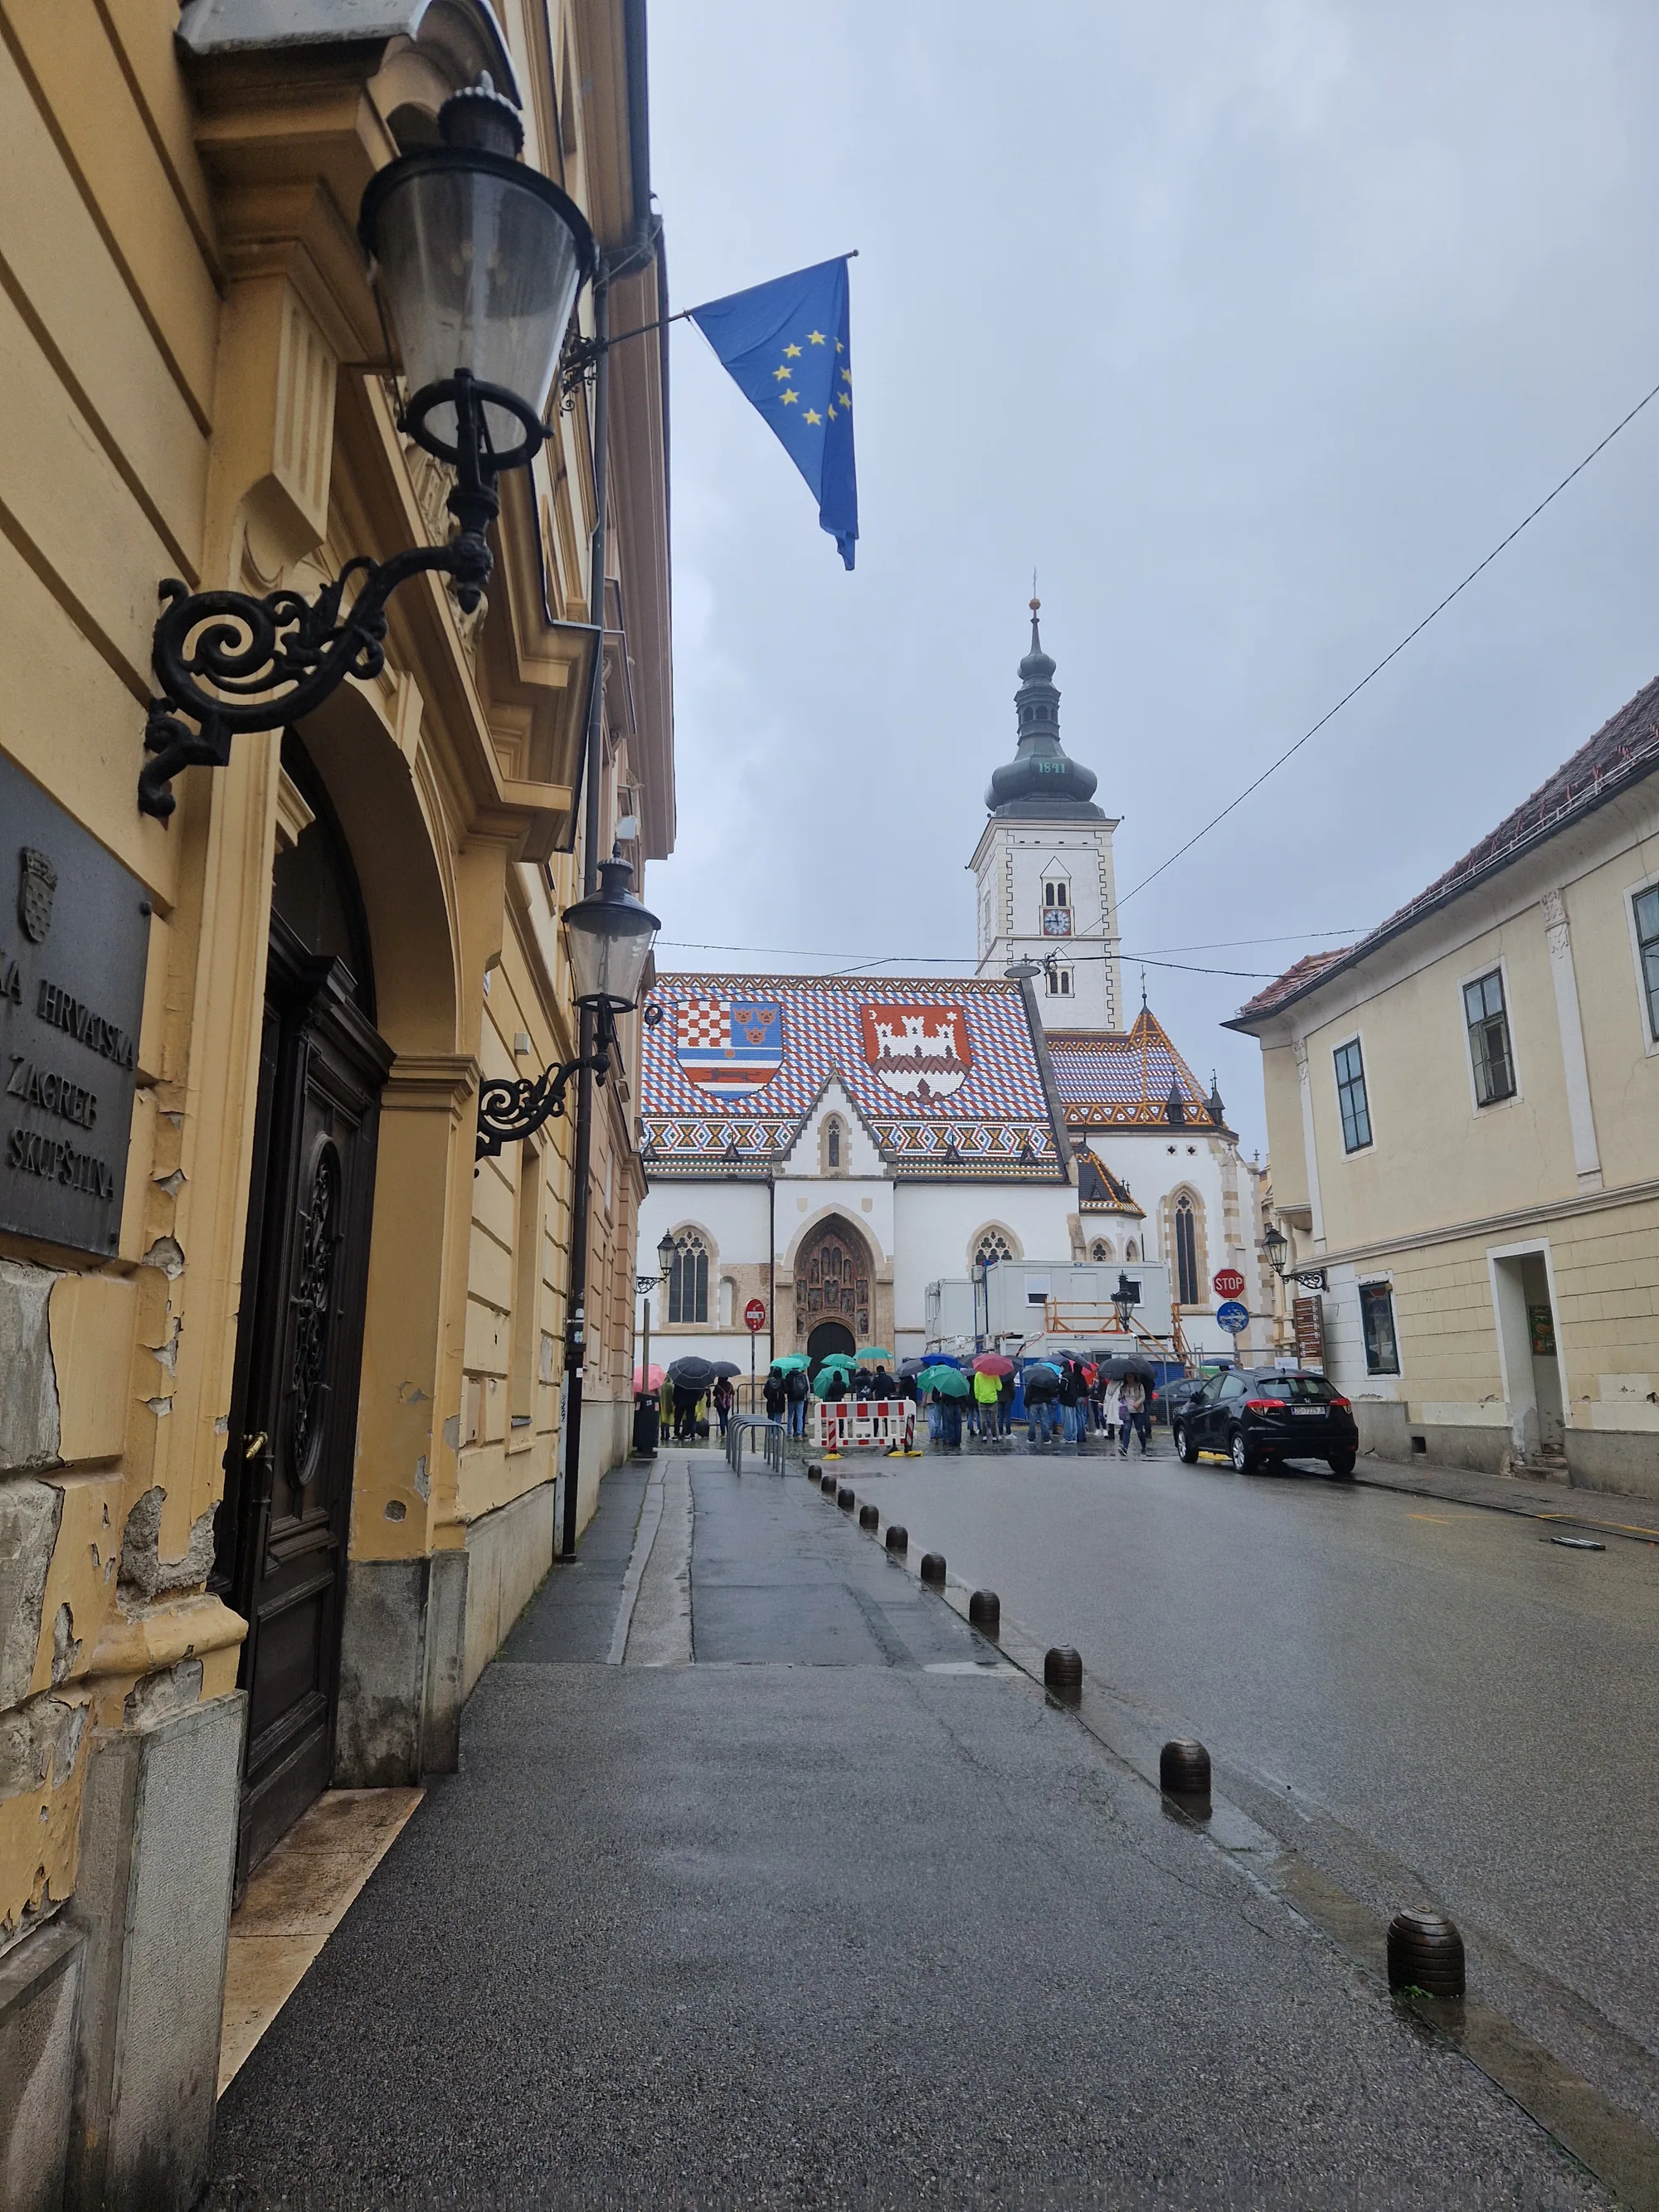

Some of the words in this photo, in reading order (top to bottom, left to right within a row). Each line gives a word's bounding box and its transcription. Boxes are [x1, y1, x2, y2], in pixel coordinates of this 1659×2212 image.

[1039, 762, 1065, 774] 1841
[38, 980, 134, 1072] HRVATSKA
[7, 1054, 97, 1129] ZAGREB
[9, 1129, 114, 1201] SKUPŠTINA
[1215, 1277, 1243, 1291] STOP
